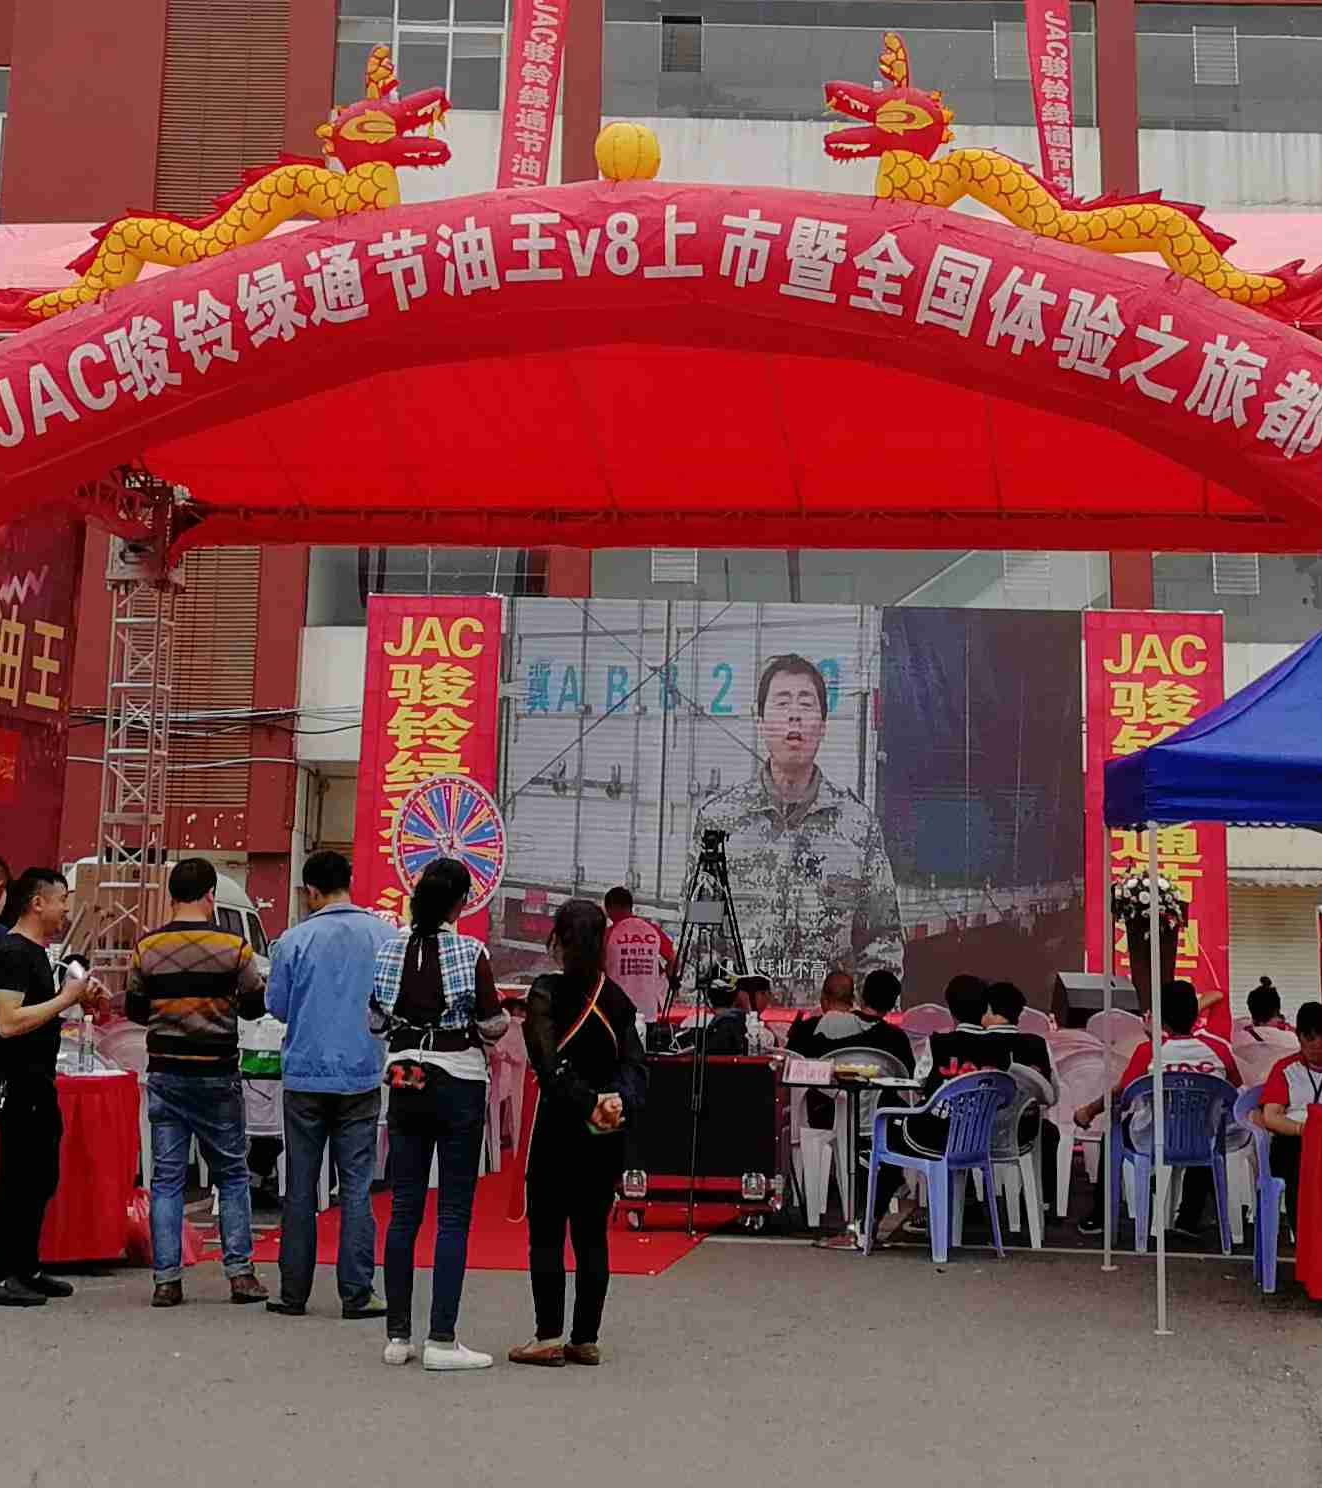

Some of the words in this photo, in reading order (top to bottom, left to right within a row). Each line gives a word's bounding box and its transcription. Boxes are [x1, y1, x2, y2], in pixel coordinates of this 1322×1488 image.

[383, 616, 485, 659] JAC
[1103, 634, 1208, 676] JAC
[617, 934, 656, 944] JAC
